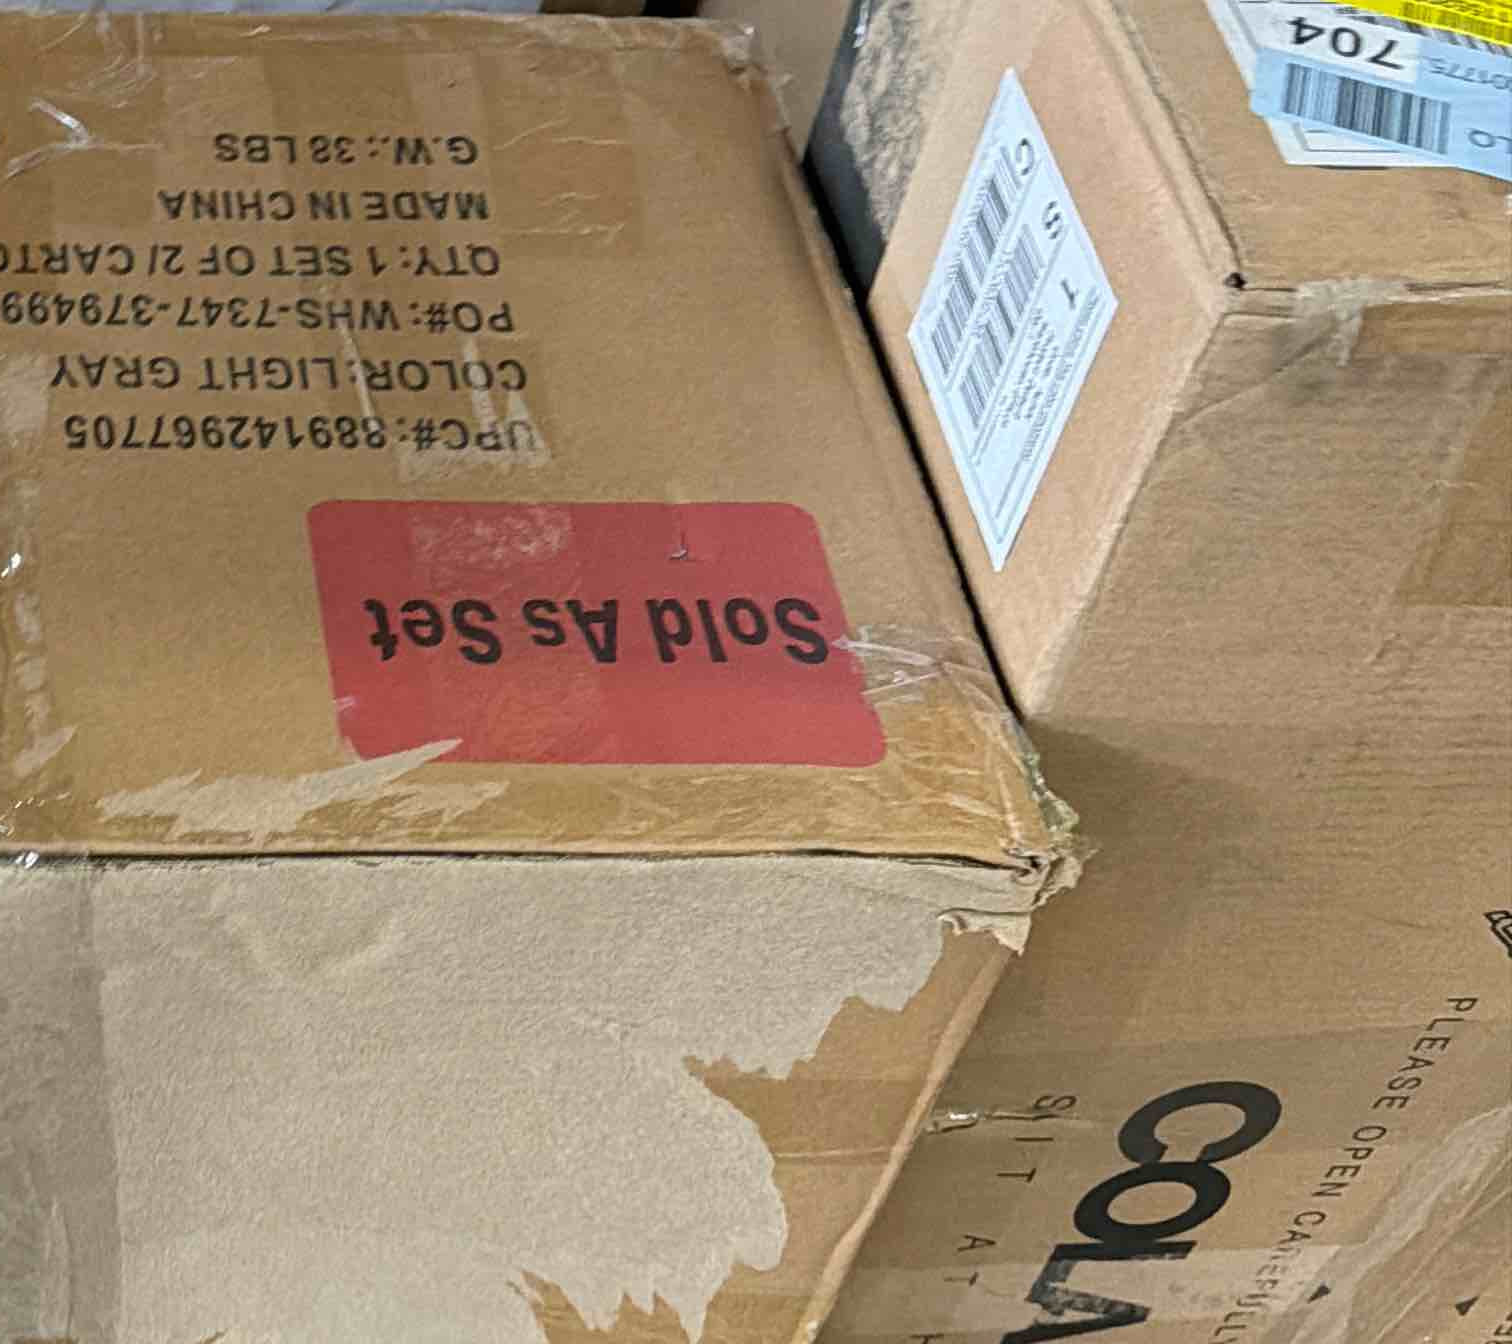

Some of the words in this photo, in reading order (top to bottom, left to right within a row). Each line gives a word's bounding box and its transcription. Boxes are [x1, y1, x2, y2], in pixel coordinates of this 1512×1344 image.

[1288, 16, 1405, 71] 704
[213, 133, 297, 165] LBS
[308, 134, 356, 165] 38
[157, 189, 296, 222] CHINA
[308, 190, 351, 222] IN
[359, 191, 489, 223] MADE
[198, 244, 256, 276] OF
[269, 243, 353, 278] SET
[399, 243, 501, 278] QTY:
[50, 354, 180, 391] GRAY
[363, 598, 503, 664] Set
[522, 598, 619, 663] As
[645, 598, 829, 664] Sold
[1372, 997, 1479, 1110] PLEASE
[1311, 1125, 1387, 1198] OPEN
[943, 1233, 997, 1287] AT
